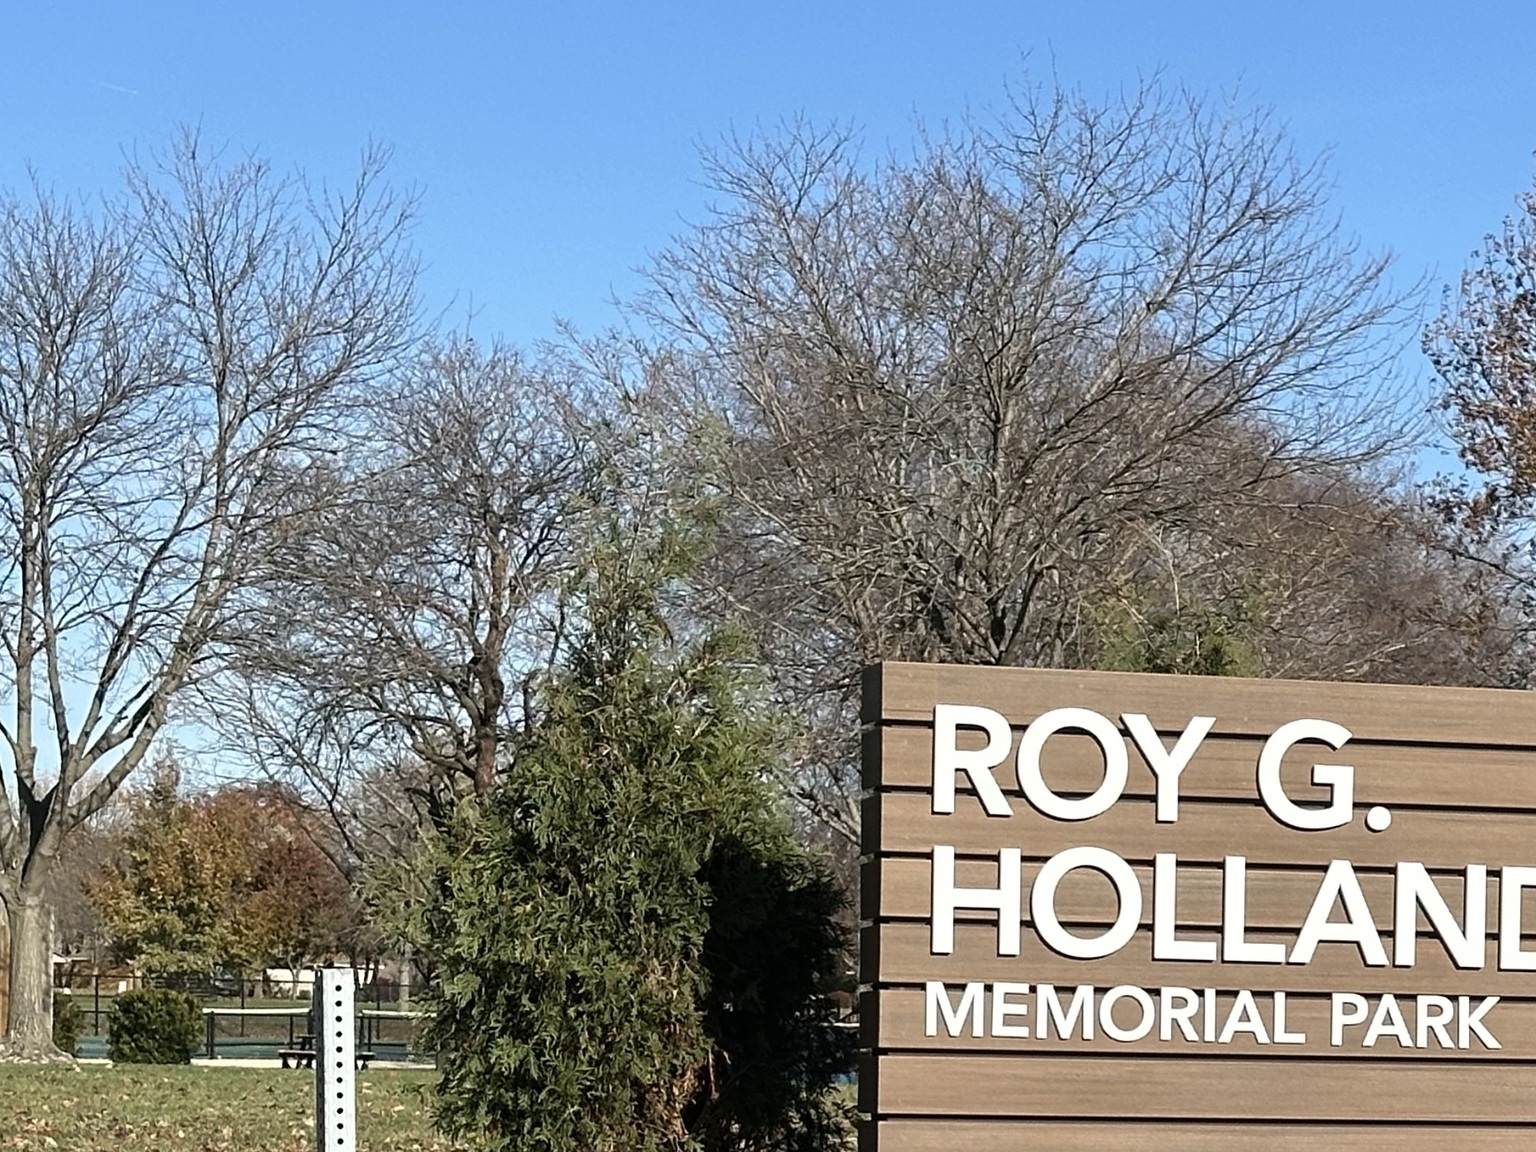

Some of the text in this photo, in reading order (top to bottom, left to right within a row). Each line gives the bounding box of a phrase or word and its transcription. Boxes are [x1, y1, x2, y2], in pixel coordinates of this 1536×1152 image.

[933, 704, 1392, 831] ROY G.
[925, 981, 1502, 1049] MEMORIAL PARK
